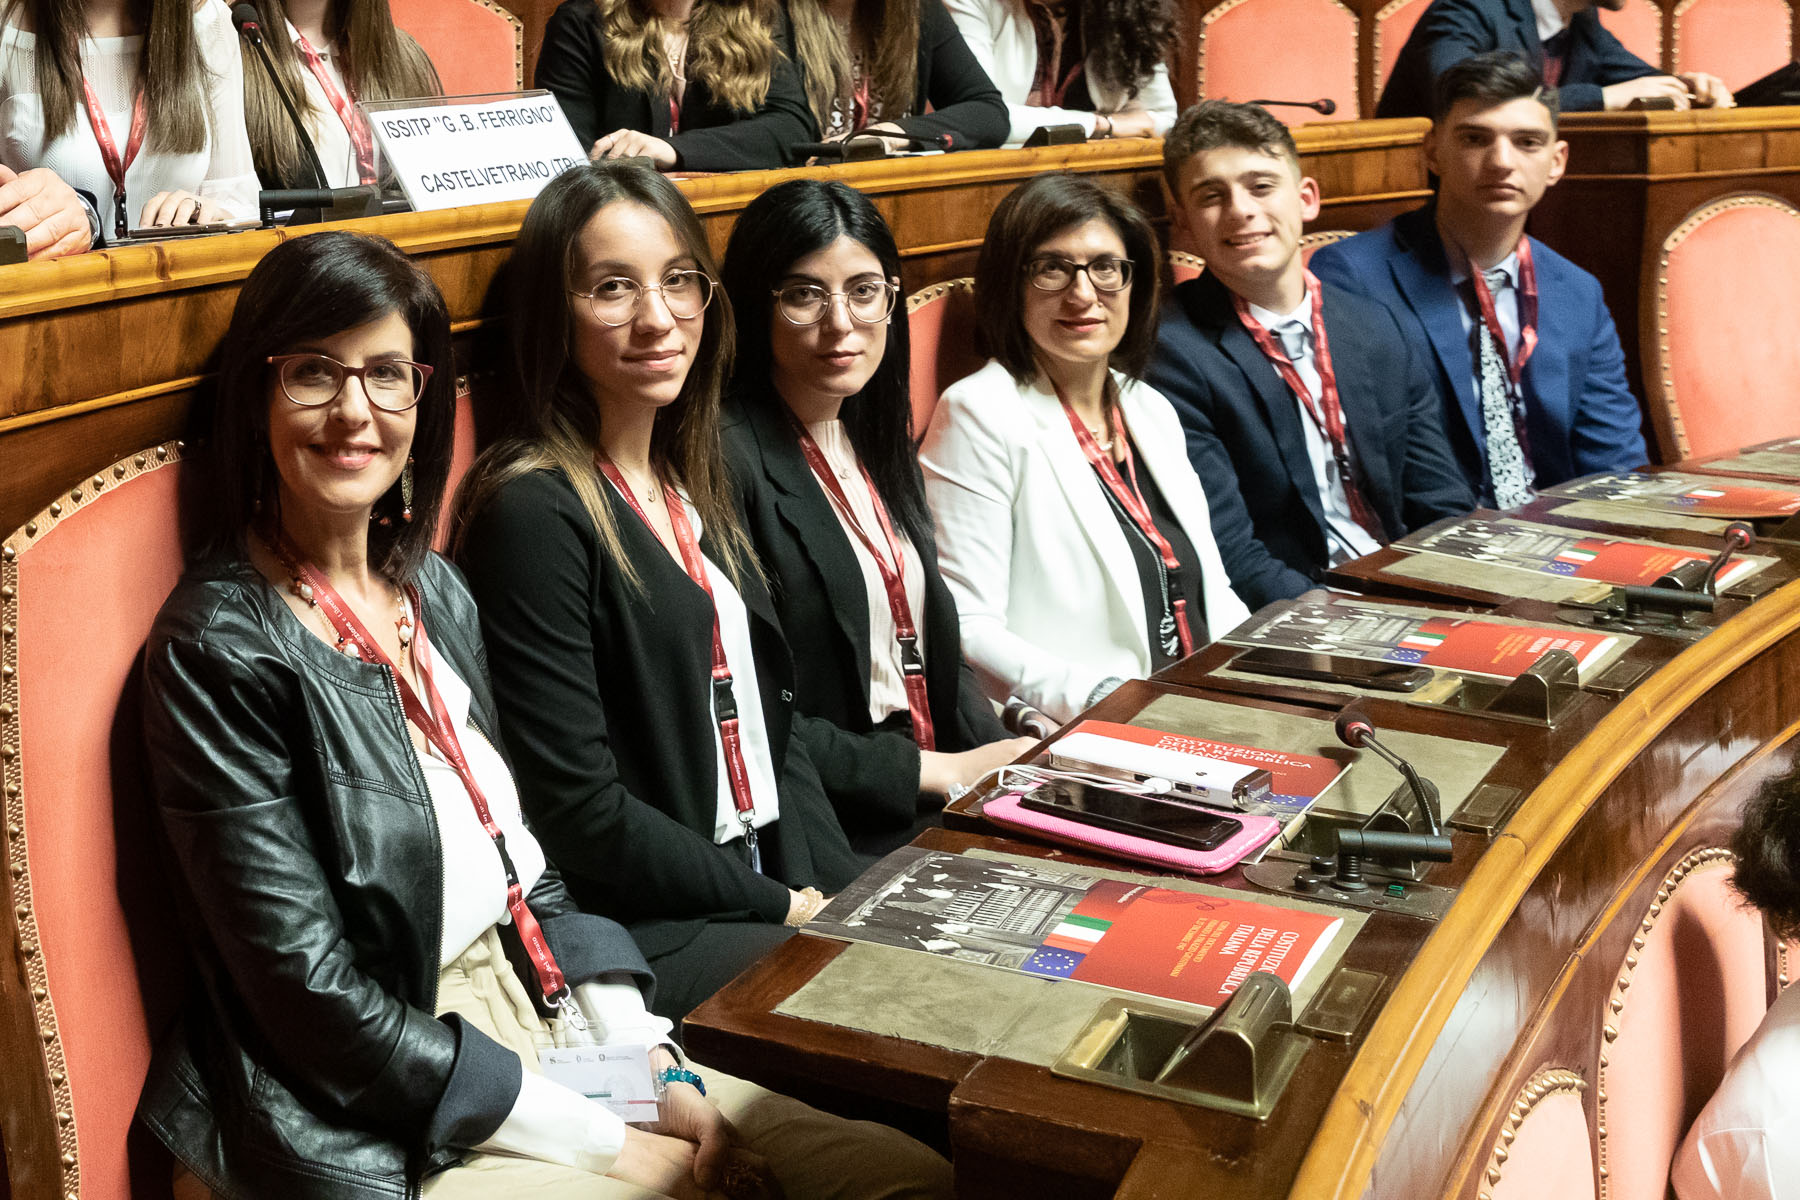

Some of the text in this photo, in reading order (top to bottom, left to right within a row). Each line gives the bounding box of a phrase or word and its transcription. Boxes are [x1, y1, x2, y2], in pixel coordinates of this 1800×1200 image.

[381, 104, 556, 139] ISSITP "G. B. FERRIGNO"
[421, 159, 550, 193] CASTELVETRANO
[323, 594, 342, 618] Libreria
[446, 734, 460, 761] Libreria
[1154, 743, 1228, 761] ITALIANA
[1159, 739, 1312, 769] DELLA REPUBBLICA
[1162, 735, 1288, 760] COSTITUZIONE
[531, 936, 552, 973] del Senato
[1218, 923, 1256, 955] ITALIANA
[1257, 931, 1300, 975] COSTITUZI
[1217, 927, 1279, 994] DELLA REPUBBLICA
